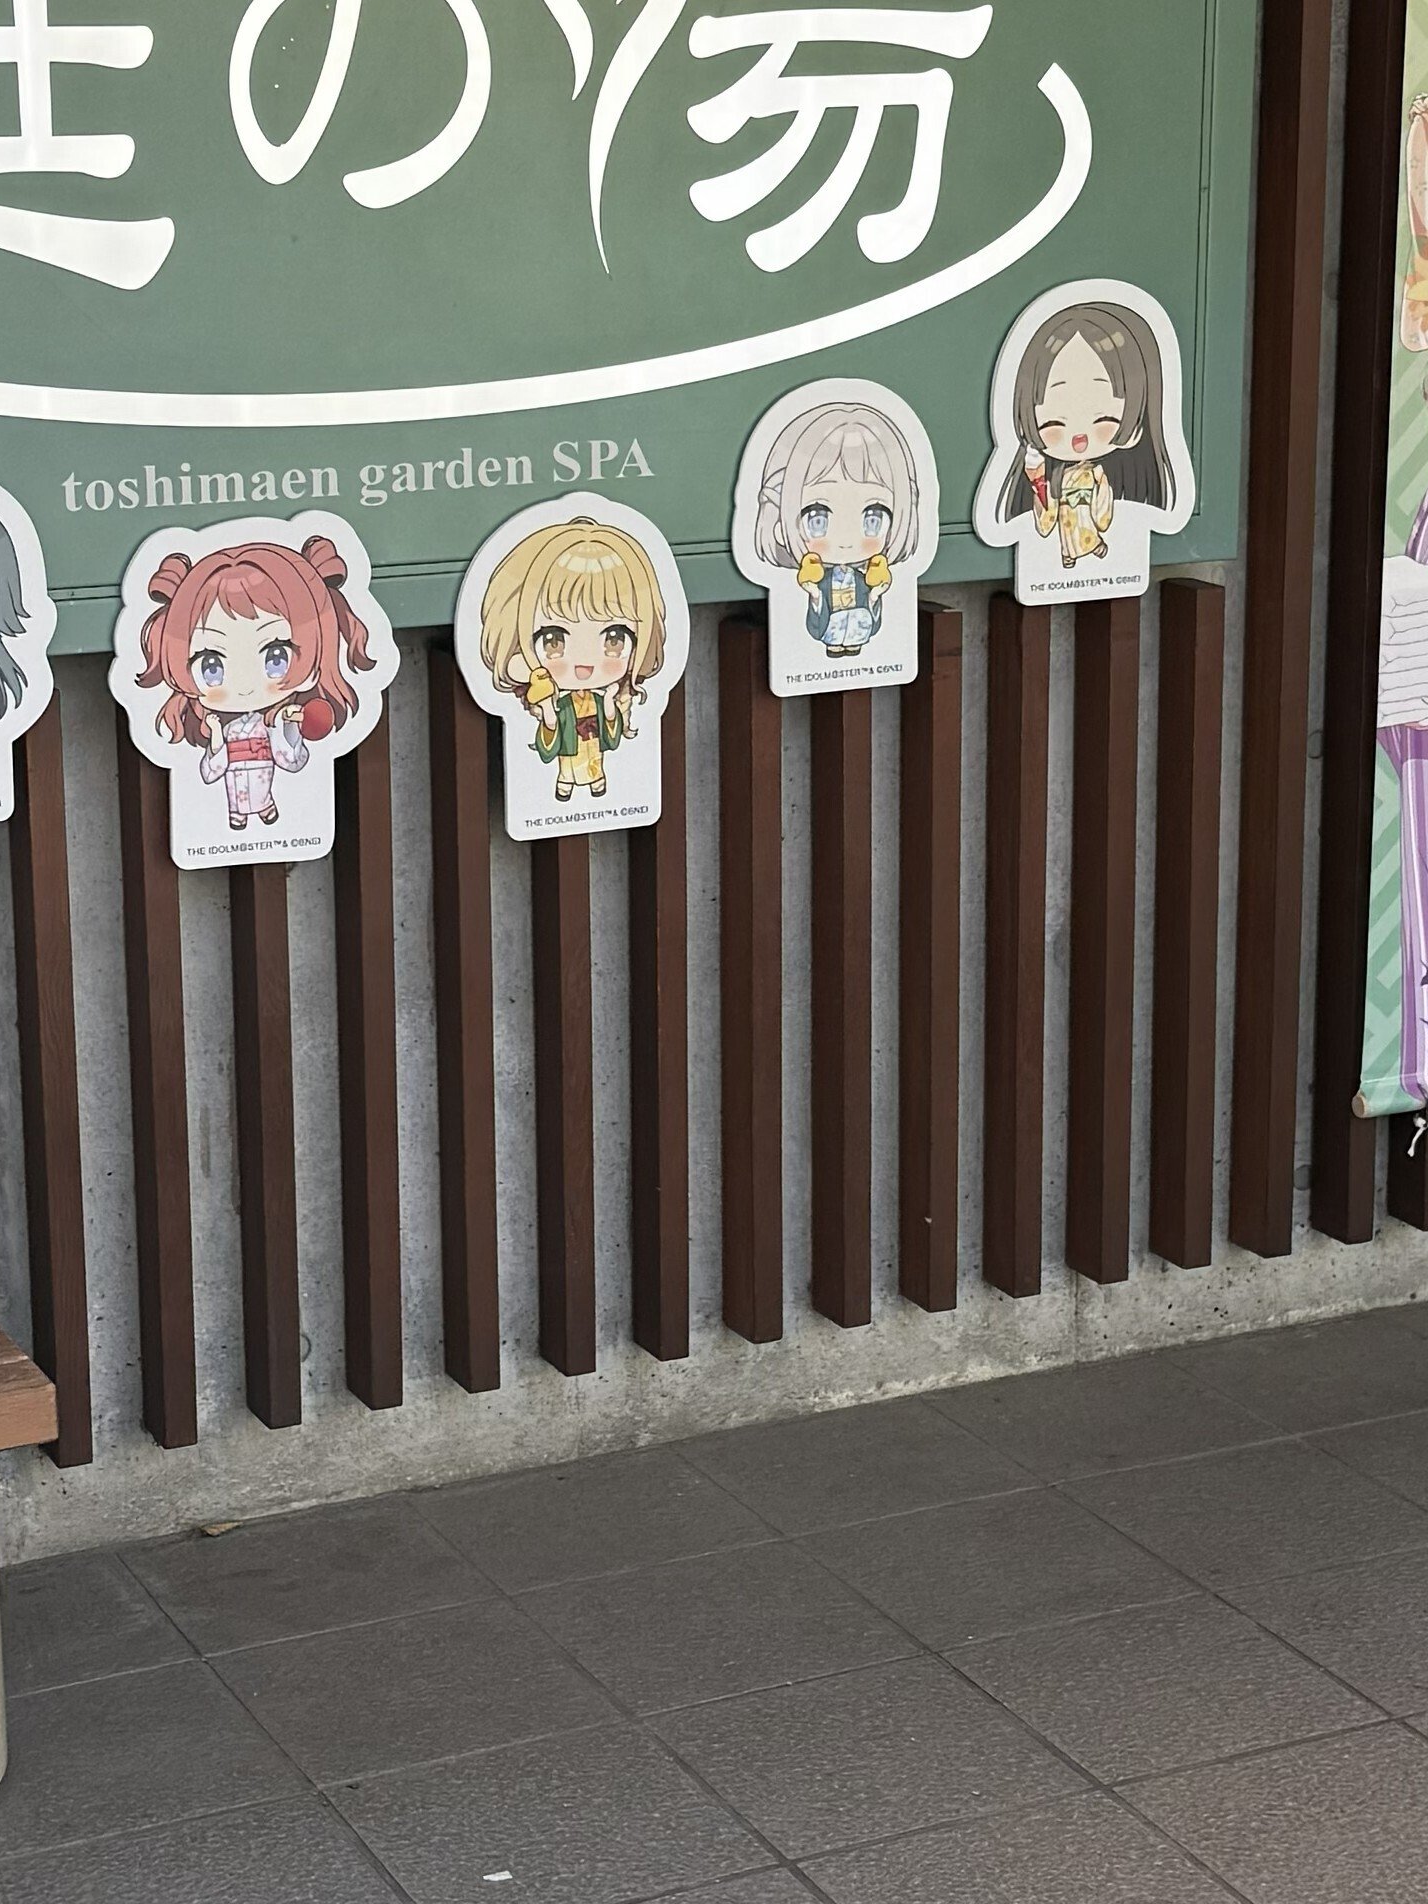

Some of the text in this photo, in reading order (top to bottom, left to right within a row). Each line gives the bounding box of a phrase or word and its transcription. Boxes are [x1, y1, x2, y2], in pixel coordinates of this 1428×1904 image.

[62, 438, 655, 512] toshimaen garden SPA
